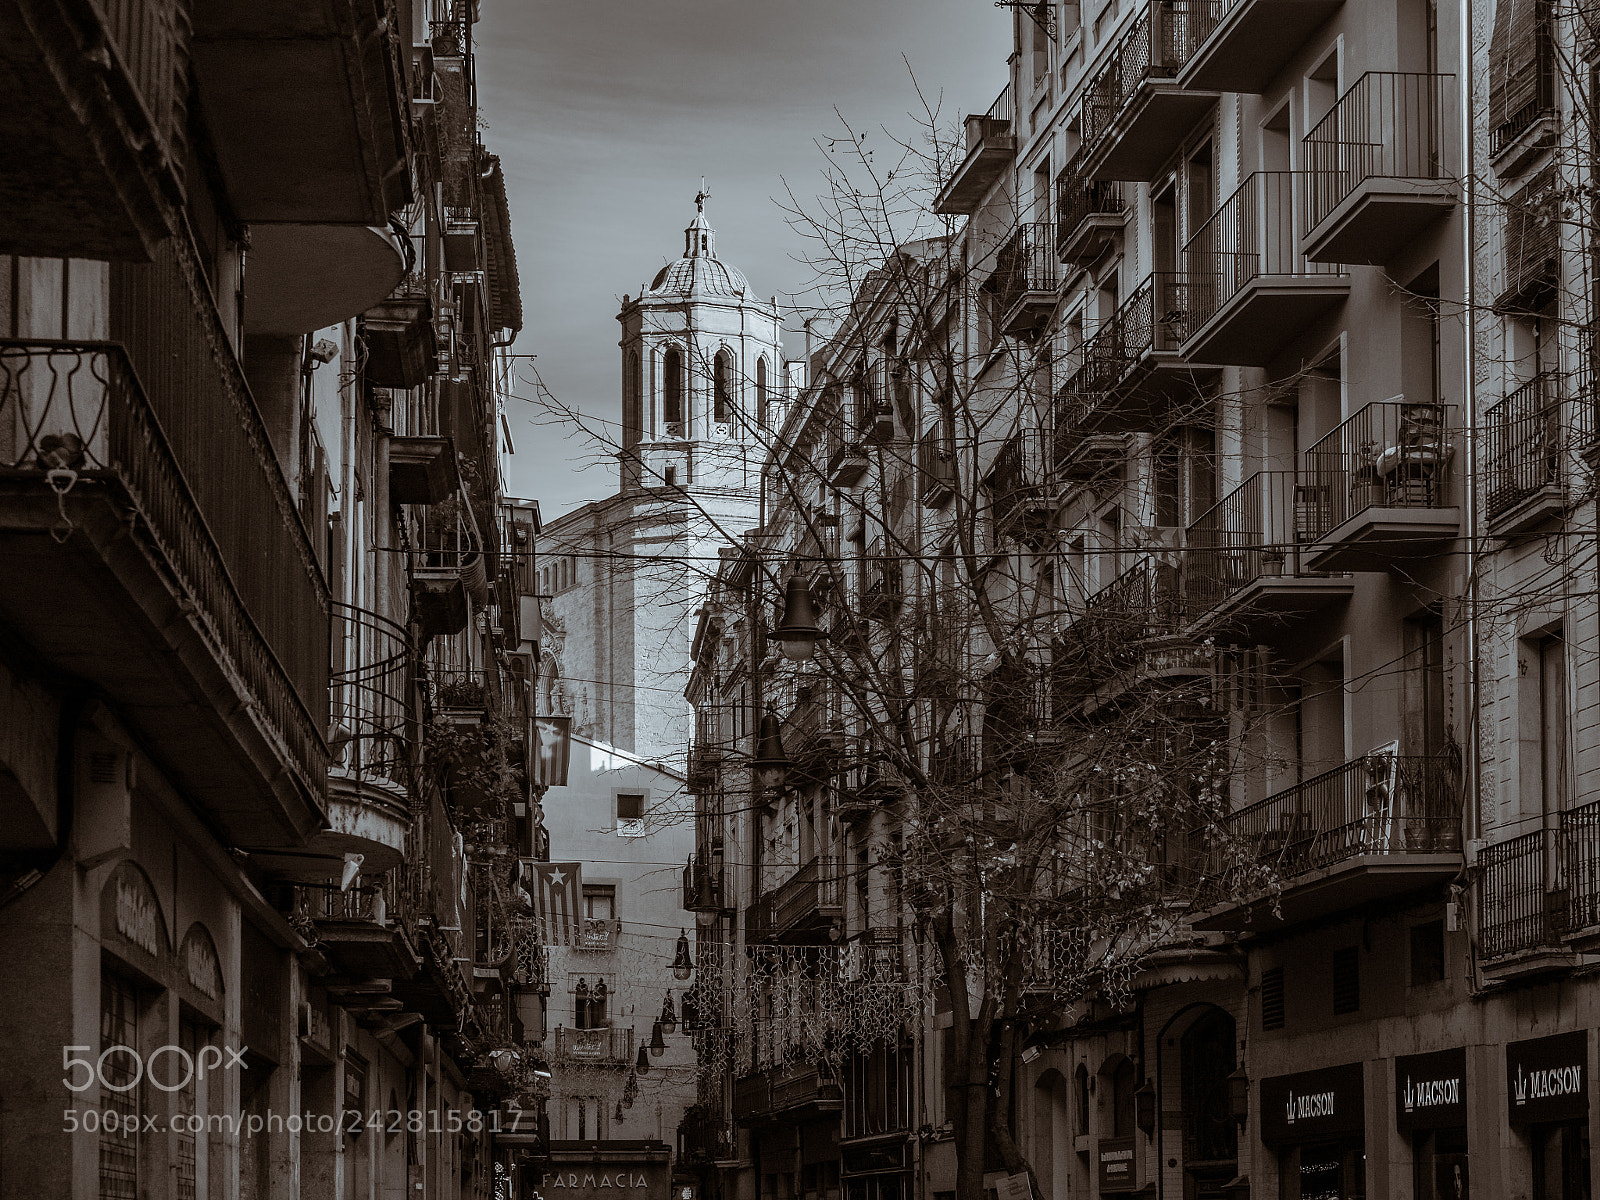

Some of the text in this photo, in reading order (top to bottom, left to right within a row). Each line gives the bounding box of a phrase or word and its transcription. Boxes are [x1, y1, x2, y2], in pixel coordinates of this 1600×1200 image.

[1416, 1078, 1460, 1107] MACSON
[1530, 1065, 1581, 1098] MACSON
[1297, 1091, 1335, 1119] MACSON
[541, 1173, 649, 1188] FARMACIA
